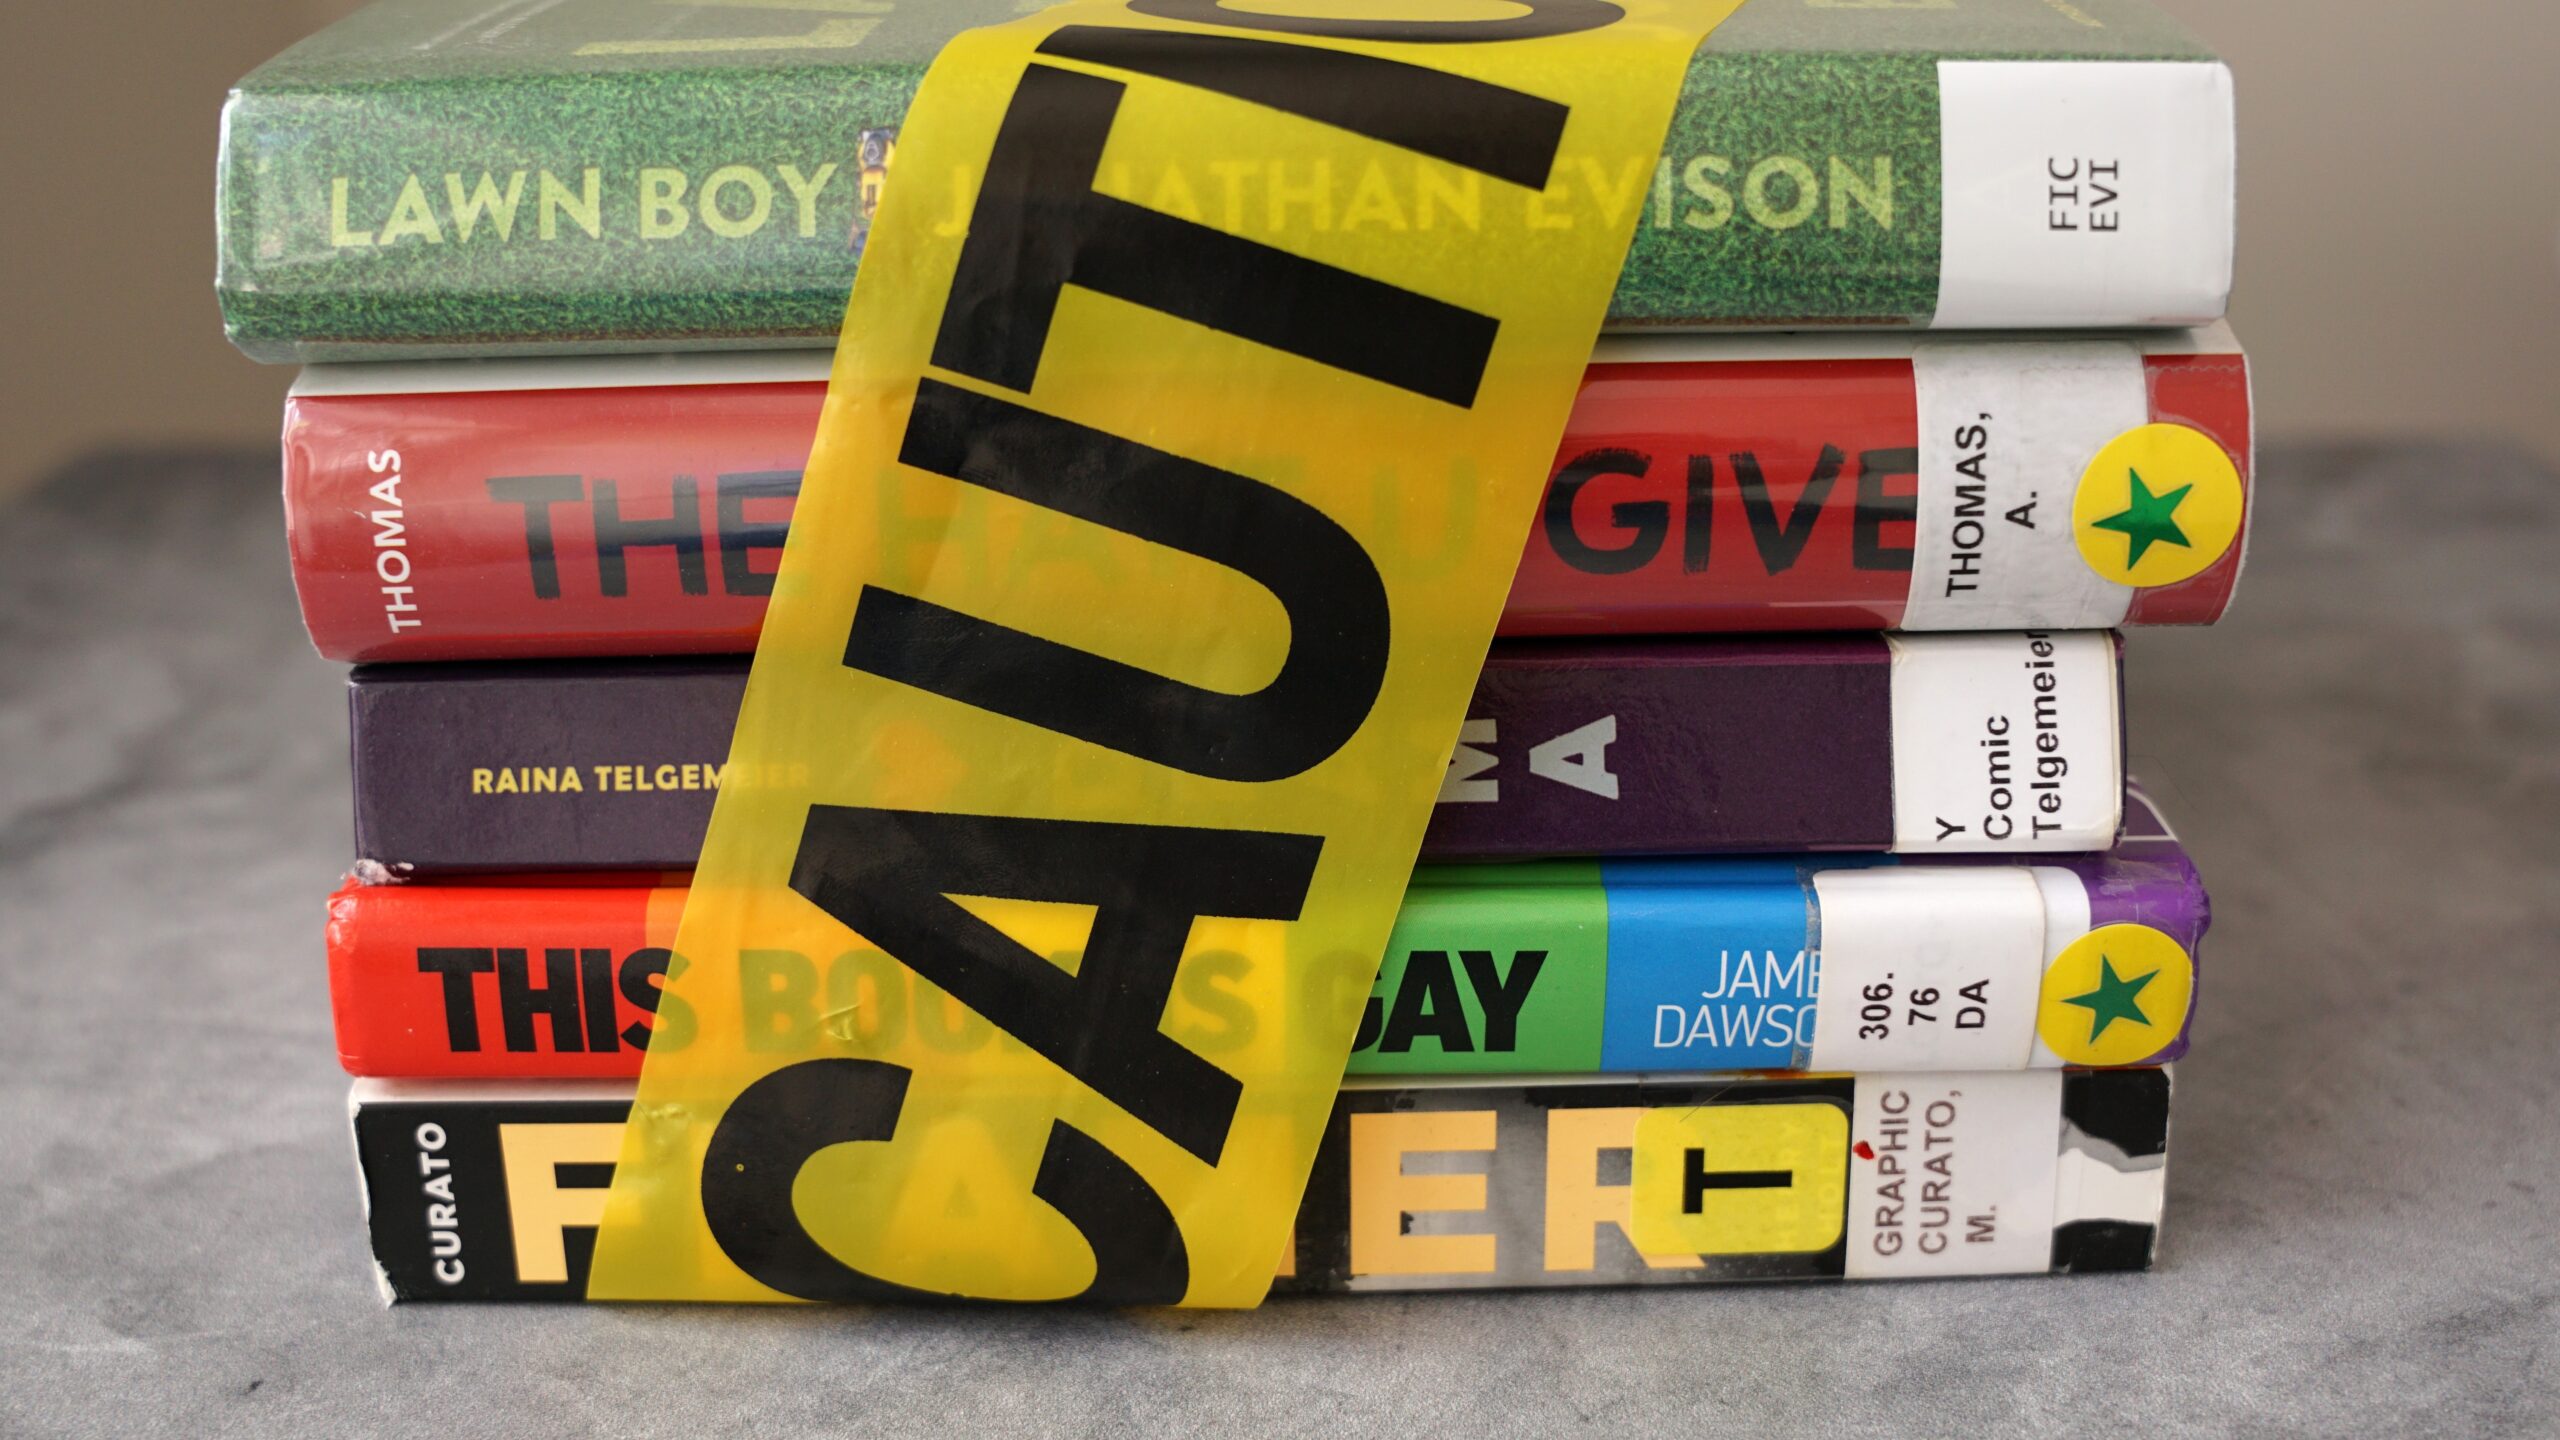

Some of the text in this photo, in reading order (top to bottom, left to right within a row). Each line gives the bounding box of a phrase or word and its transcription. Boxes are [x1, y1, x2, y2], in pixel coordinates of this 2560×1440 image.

[332, 162, 838, 248] LAWN BOY
[2049, 155, 2078, 232] FIC
[2089, 158, 2119, 233] EVI
[367, 447, 422, 634] THOMAS
[485, 469, 808, 600] THE
[1543, 442, 1919, 577] GIVE
[1946, 412, 1994, 598] THOMAS,
[2005, 490, 2038, 530] A.
[2024, 631, 2068, 840] Telgemeier
[471, 766, 583, 794] RAINA
[1980, 715, 2013, 841] Comic
[1935, 816, 1966, 842] Y
[417, 947, 699, 1053] THIS
[1303, 949, 1549, 1053] GAY
[1858, 971, 1895, 1040] 306.
[1908, 986, 1941, 1027] 76
[1955, 978, 1990, 1030] DA
[415, 1120, 466, 1286] CURATO
[1681, 1147, 1793, 1215] T
[1872, 1090, 1912, 1257] GRAPHIC
[1917, 1088, 1963, 1256] CURATO,
[1965, 1203, 1998, 1244] M.
